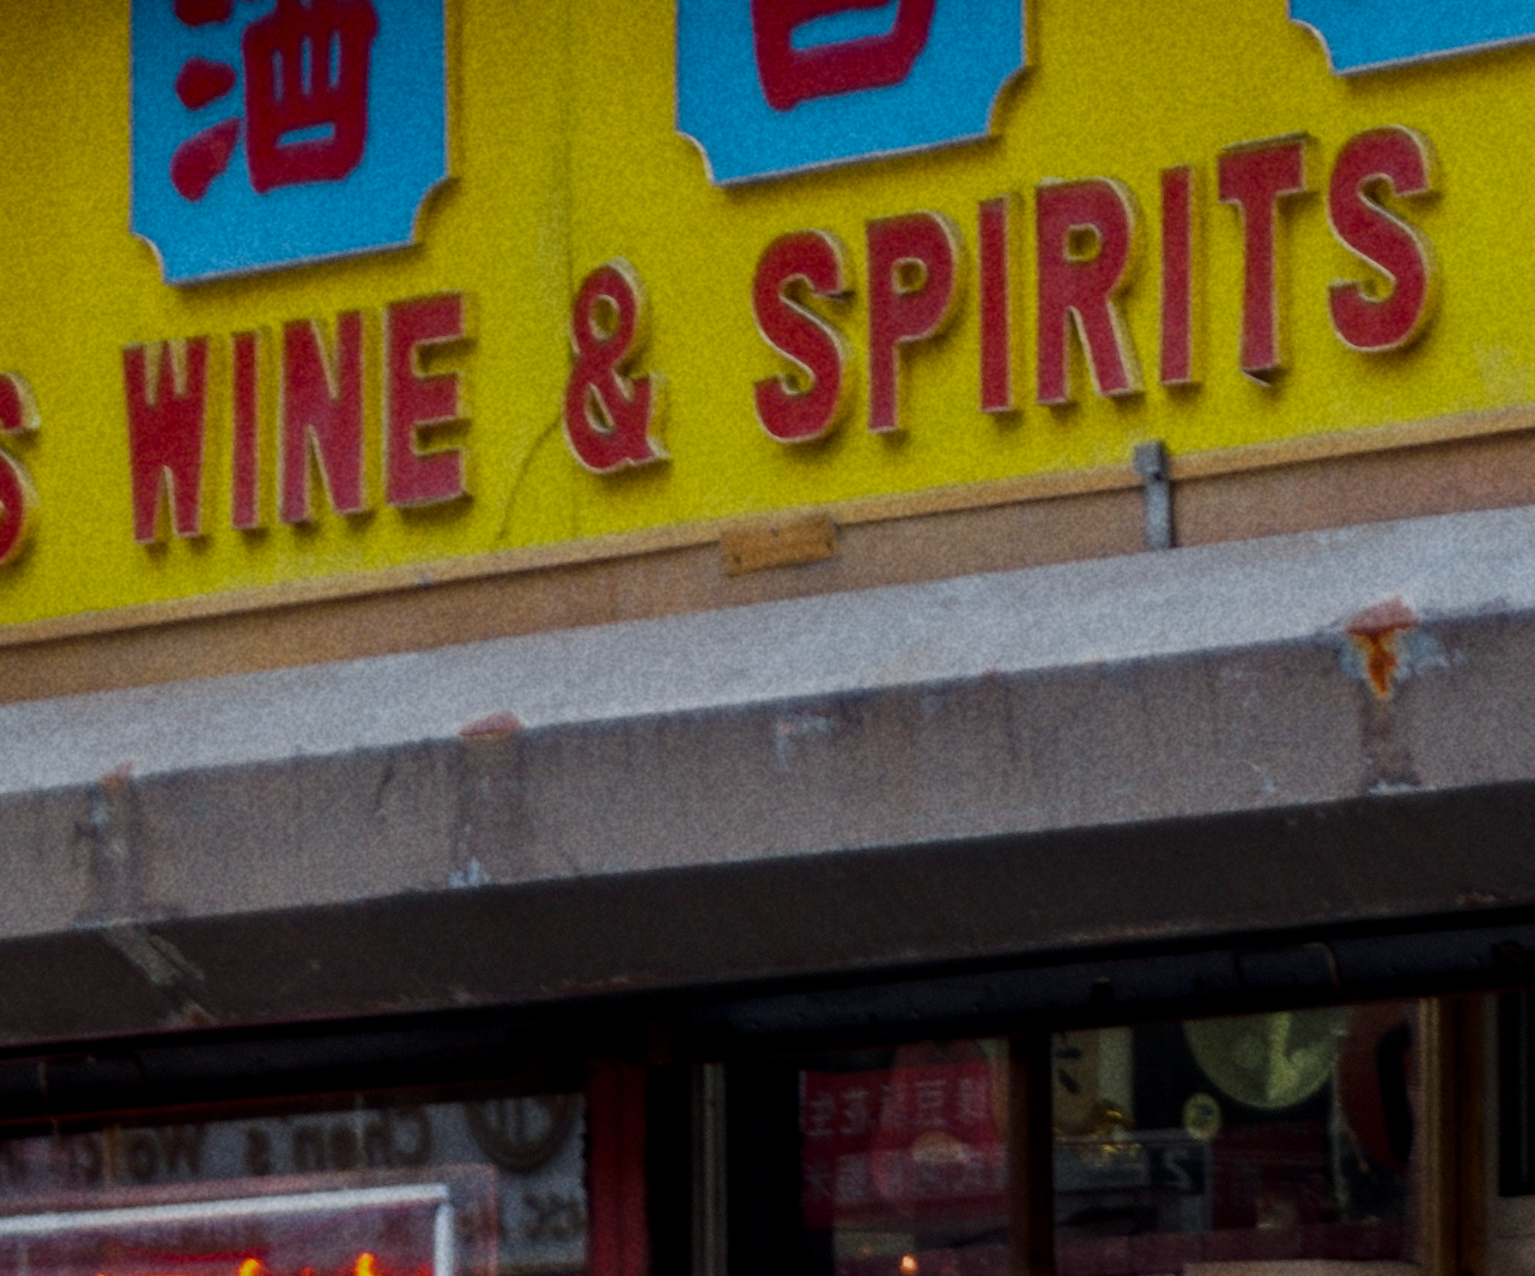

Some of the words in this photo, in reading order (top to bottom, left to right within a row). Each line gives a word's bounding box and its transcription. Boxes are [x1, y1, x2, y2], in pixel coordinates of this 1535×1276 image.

[121, 290, 470, 545] WINE
[564, 256, 667, 475] &
[751, 122, 1440, 446] SPIRITS
